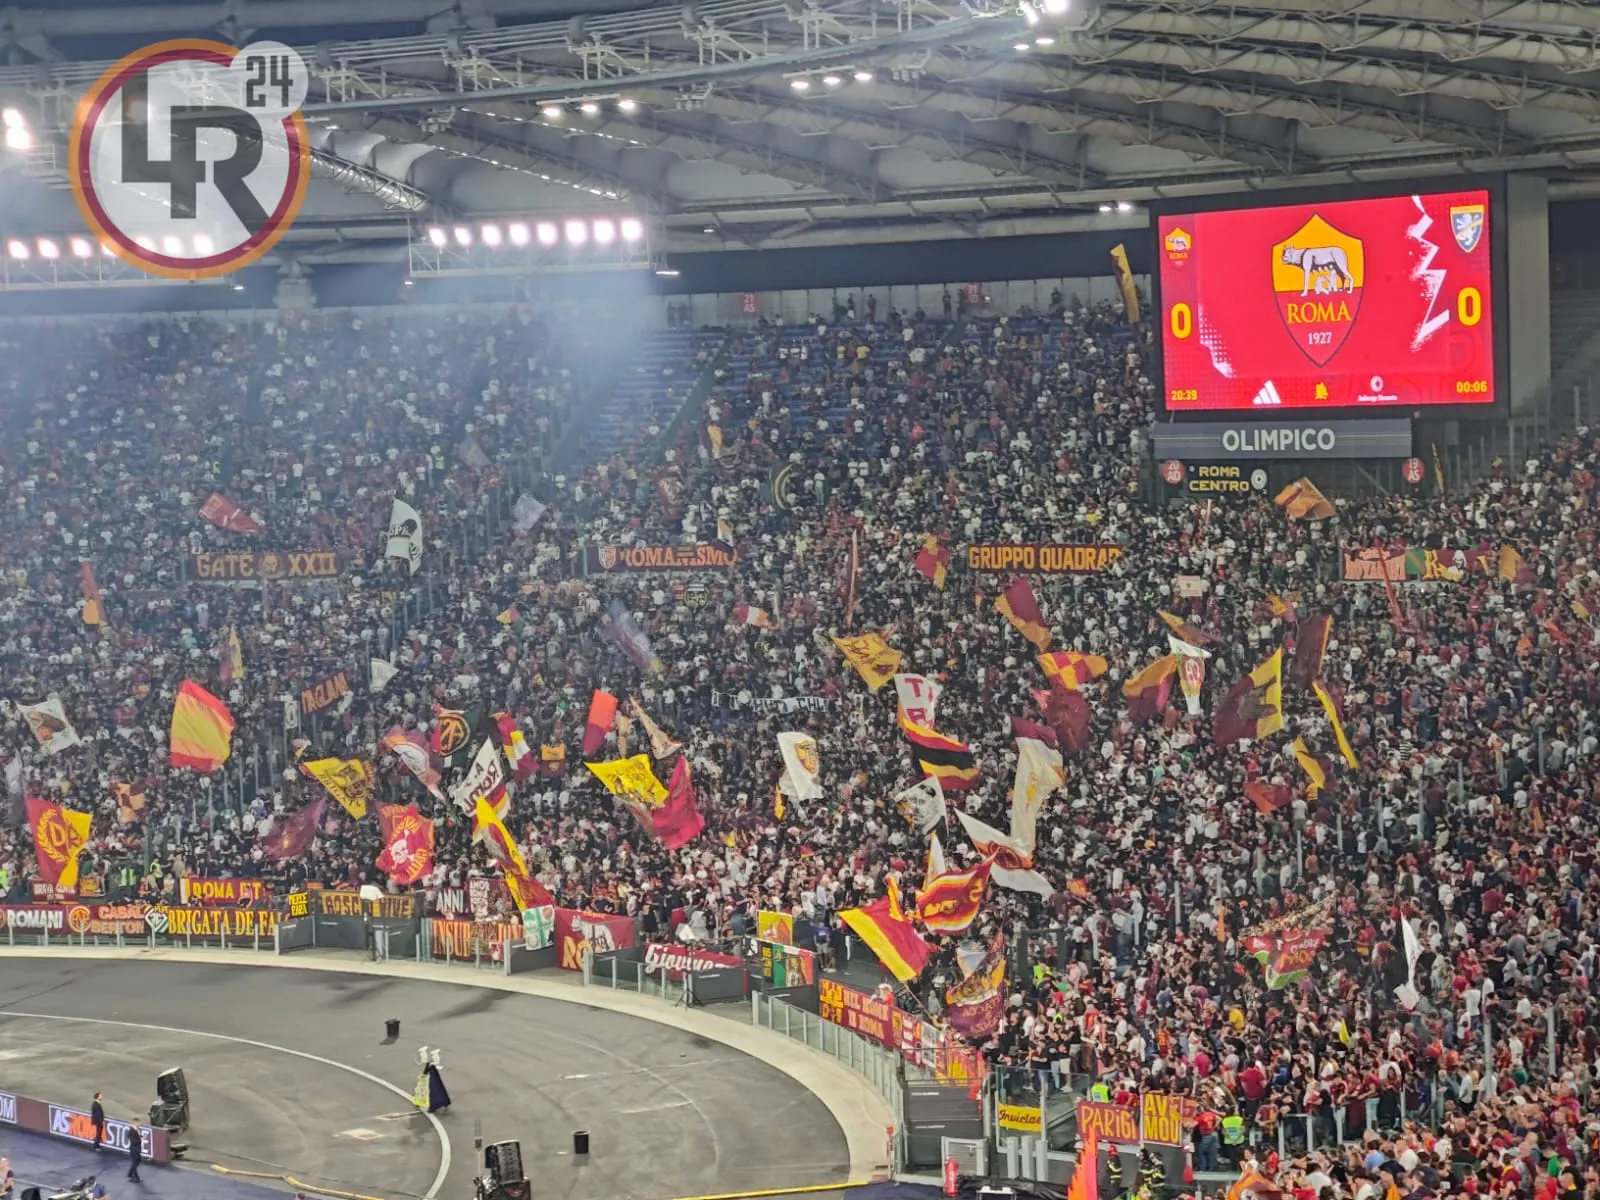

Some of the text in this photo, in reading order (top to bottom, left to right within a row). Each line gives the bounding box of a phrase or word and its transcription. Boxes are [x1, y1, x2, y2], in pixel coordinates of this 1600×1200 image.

[1287, 301, 1351, 324] ROMA
[1457, 287, 1481, 326] 0
[1171, 303, 1192, 339] 0
[1307, 332, 1332, 345] 1927
[1171, 389, 1198, 401] 20:39
[1456, 381, 1488, 393] 00:06
[1222, 428, 1336, 451] OLIMPICO
[1199, 466, 1240, 477] ROMA
[1189, 480, 1249, 491] CENTRO
[197, 553, 338, 577] GATE XXII
[969, 547, 1034, 569] GRUPPO
[193, 882, 234, 898] ROMA
[7, 909, 63, 929] ROMANI
[168, 910, 231, 935] BRIGATA
[235, 911, 255, 935] DE
[1144, 1116, 1179, 1143] MOU
